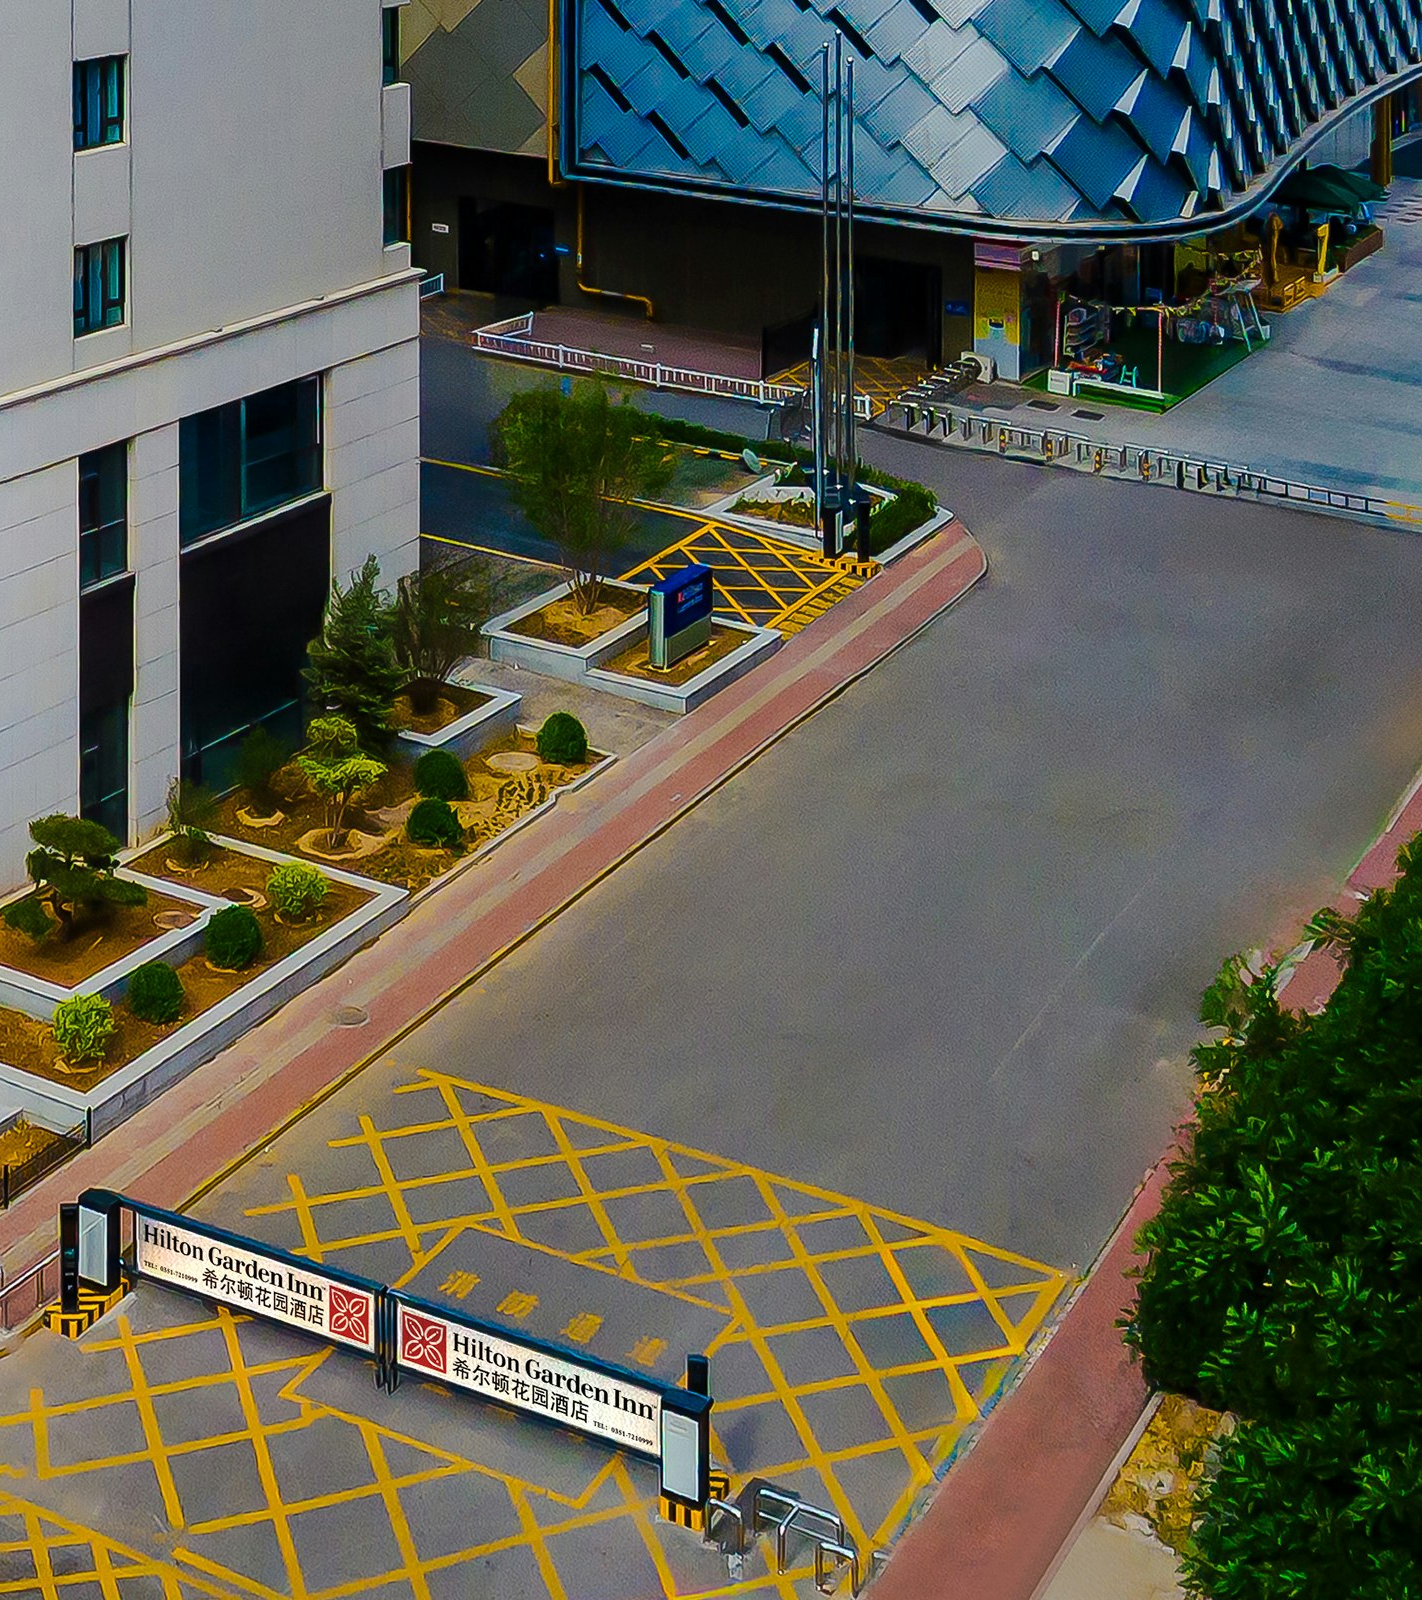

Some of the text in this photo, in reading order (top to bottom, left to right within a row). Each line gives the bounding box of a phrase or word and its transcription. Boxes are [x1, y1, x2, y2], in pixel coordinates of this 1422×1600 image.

[143, 1223, 324, 1303] Hilton Garden Inn
[159, 1265, 198, 1283] 0351-7210999
[202, 1267, 325, 1327] 希尔顿花园酒店
[452, 1332, 655, 1422] Hilton Garden Inn
[452, 1357, 589, 1424] 希尔顿花园酒店
[610, 1427, 654, 1446] 0351-7210999
